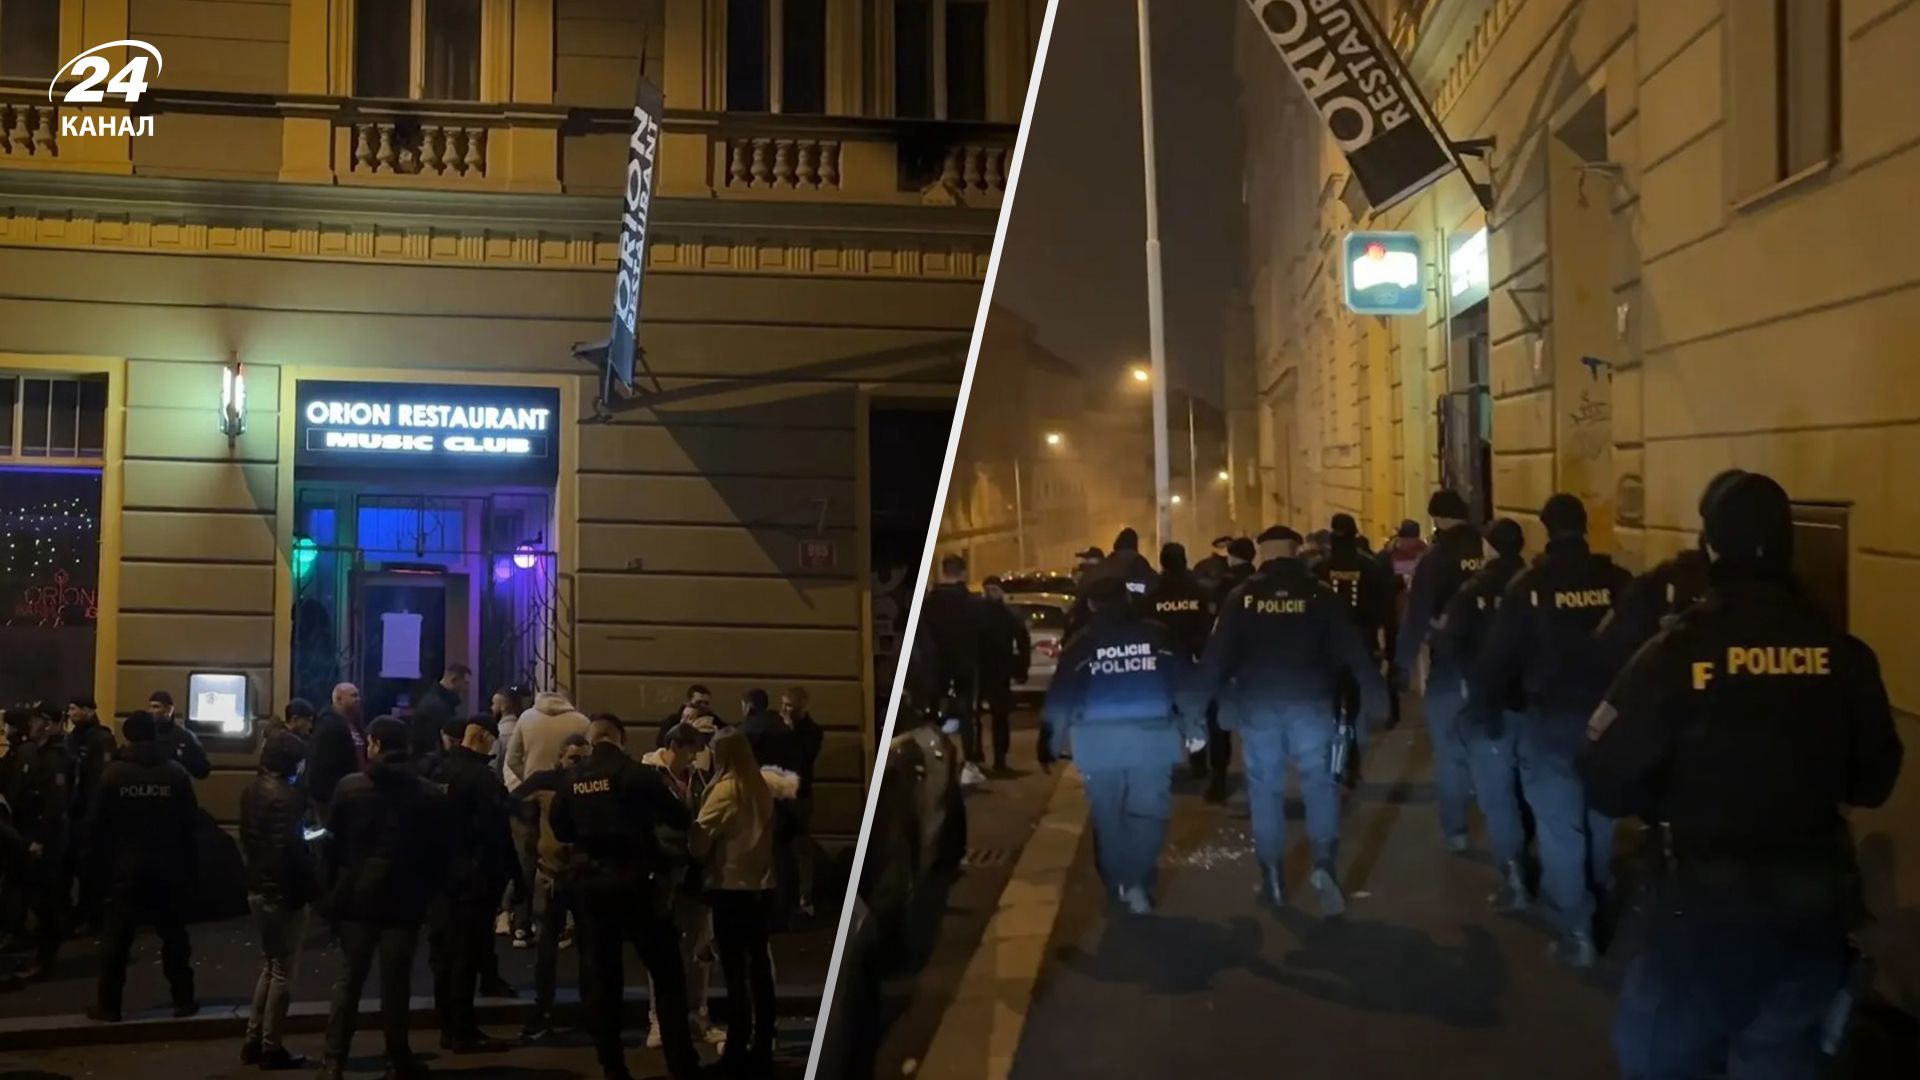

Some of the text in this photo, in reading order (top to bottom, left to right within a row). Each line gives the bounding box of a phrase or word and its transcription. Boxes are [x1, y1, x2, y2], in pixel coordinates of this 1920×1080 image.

[1250, 0, 1374, 153] ORIO
[615, 105, 649, 323] ORION
[306, 401, 550, 431] ORION RESTAURANT
[326, 432, 531, 454] MUSIC CLUB
[1155, 599, 1200, 612] POLICIE
[1257, 599, 1307, 613] POLICIE
[1553, 588, 1611, 608] POLICIE
[1096, 643, 1151, 660] POLICIE
[1090, 656, 1157, 676] POLICIE
[1691, 646, 1832, 691] F POLICIE
[573, 778, 611, 796] POLICIE
